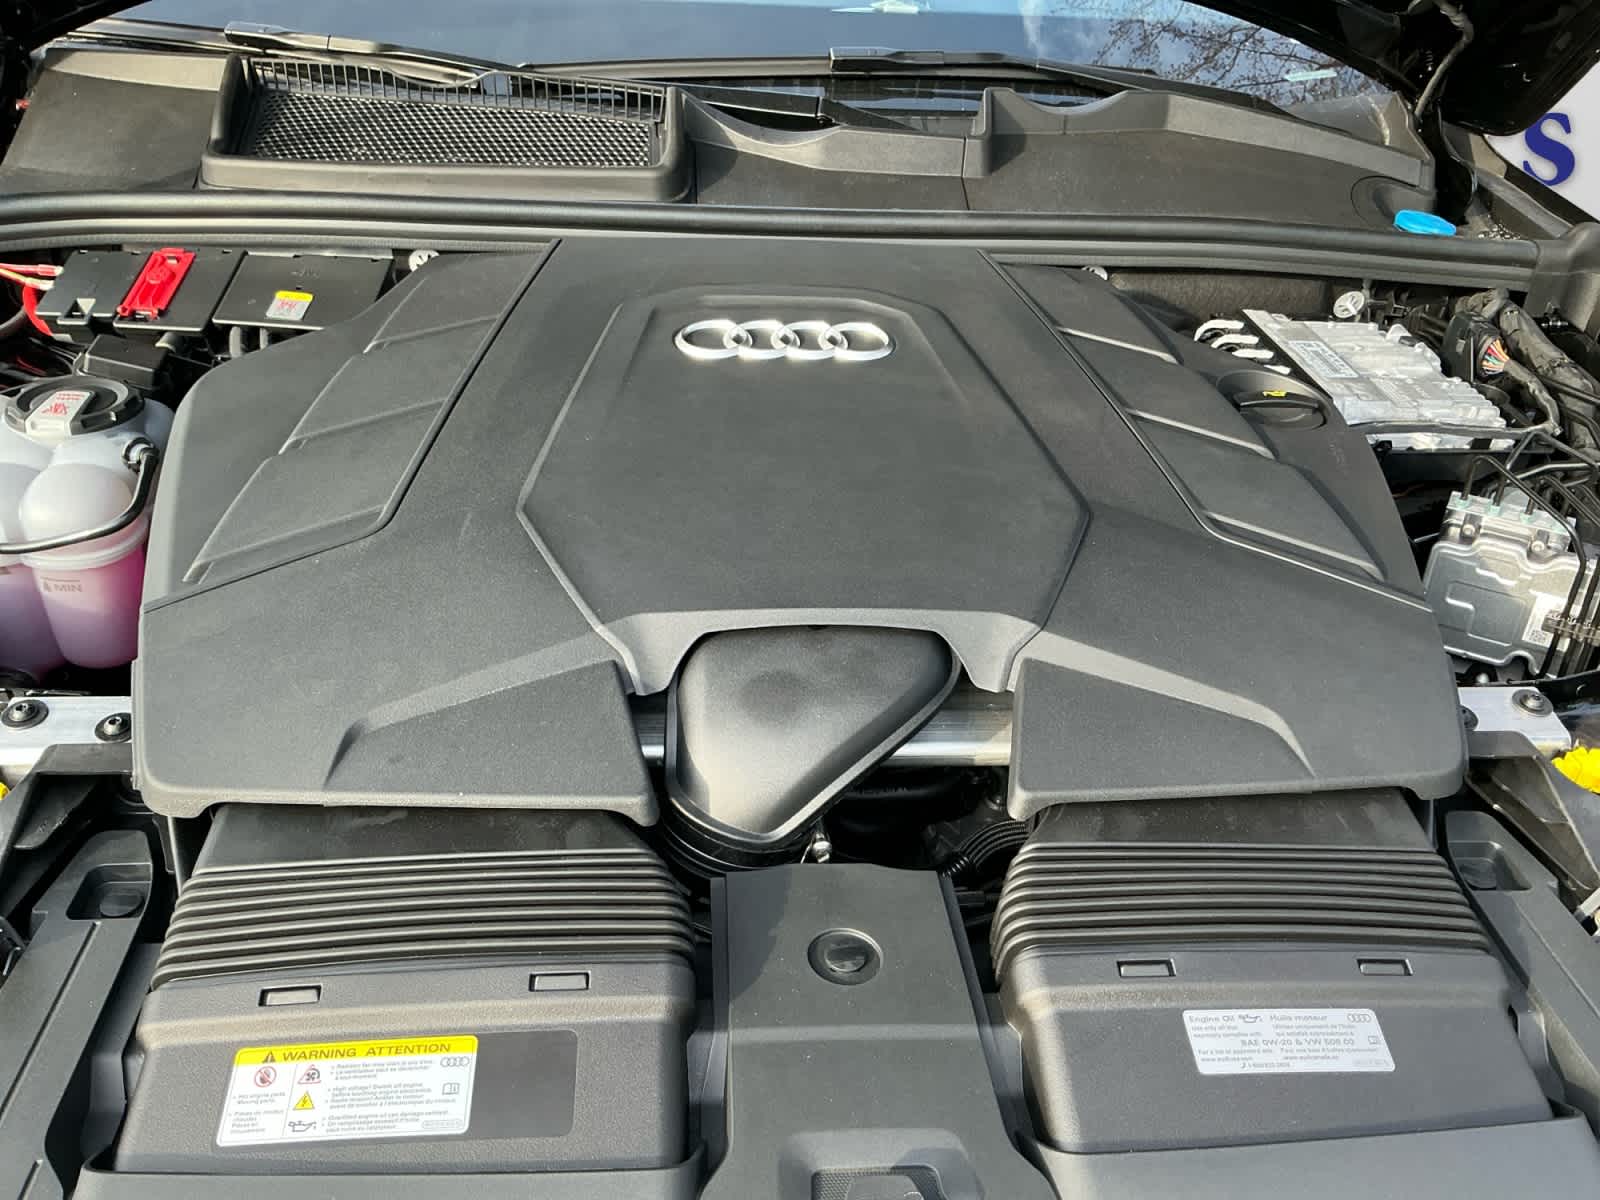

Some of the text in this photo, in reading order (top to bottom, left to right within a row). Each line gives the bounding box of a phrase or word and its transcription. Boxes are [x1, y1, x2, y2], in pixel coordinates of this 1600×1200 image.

[1522, 112, 1576, 187] S
[54, 583, 82, 593] MIN
[282, 1043, 452, 1062] WARNING ATTENTION
